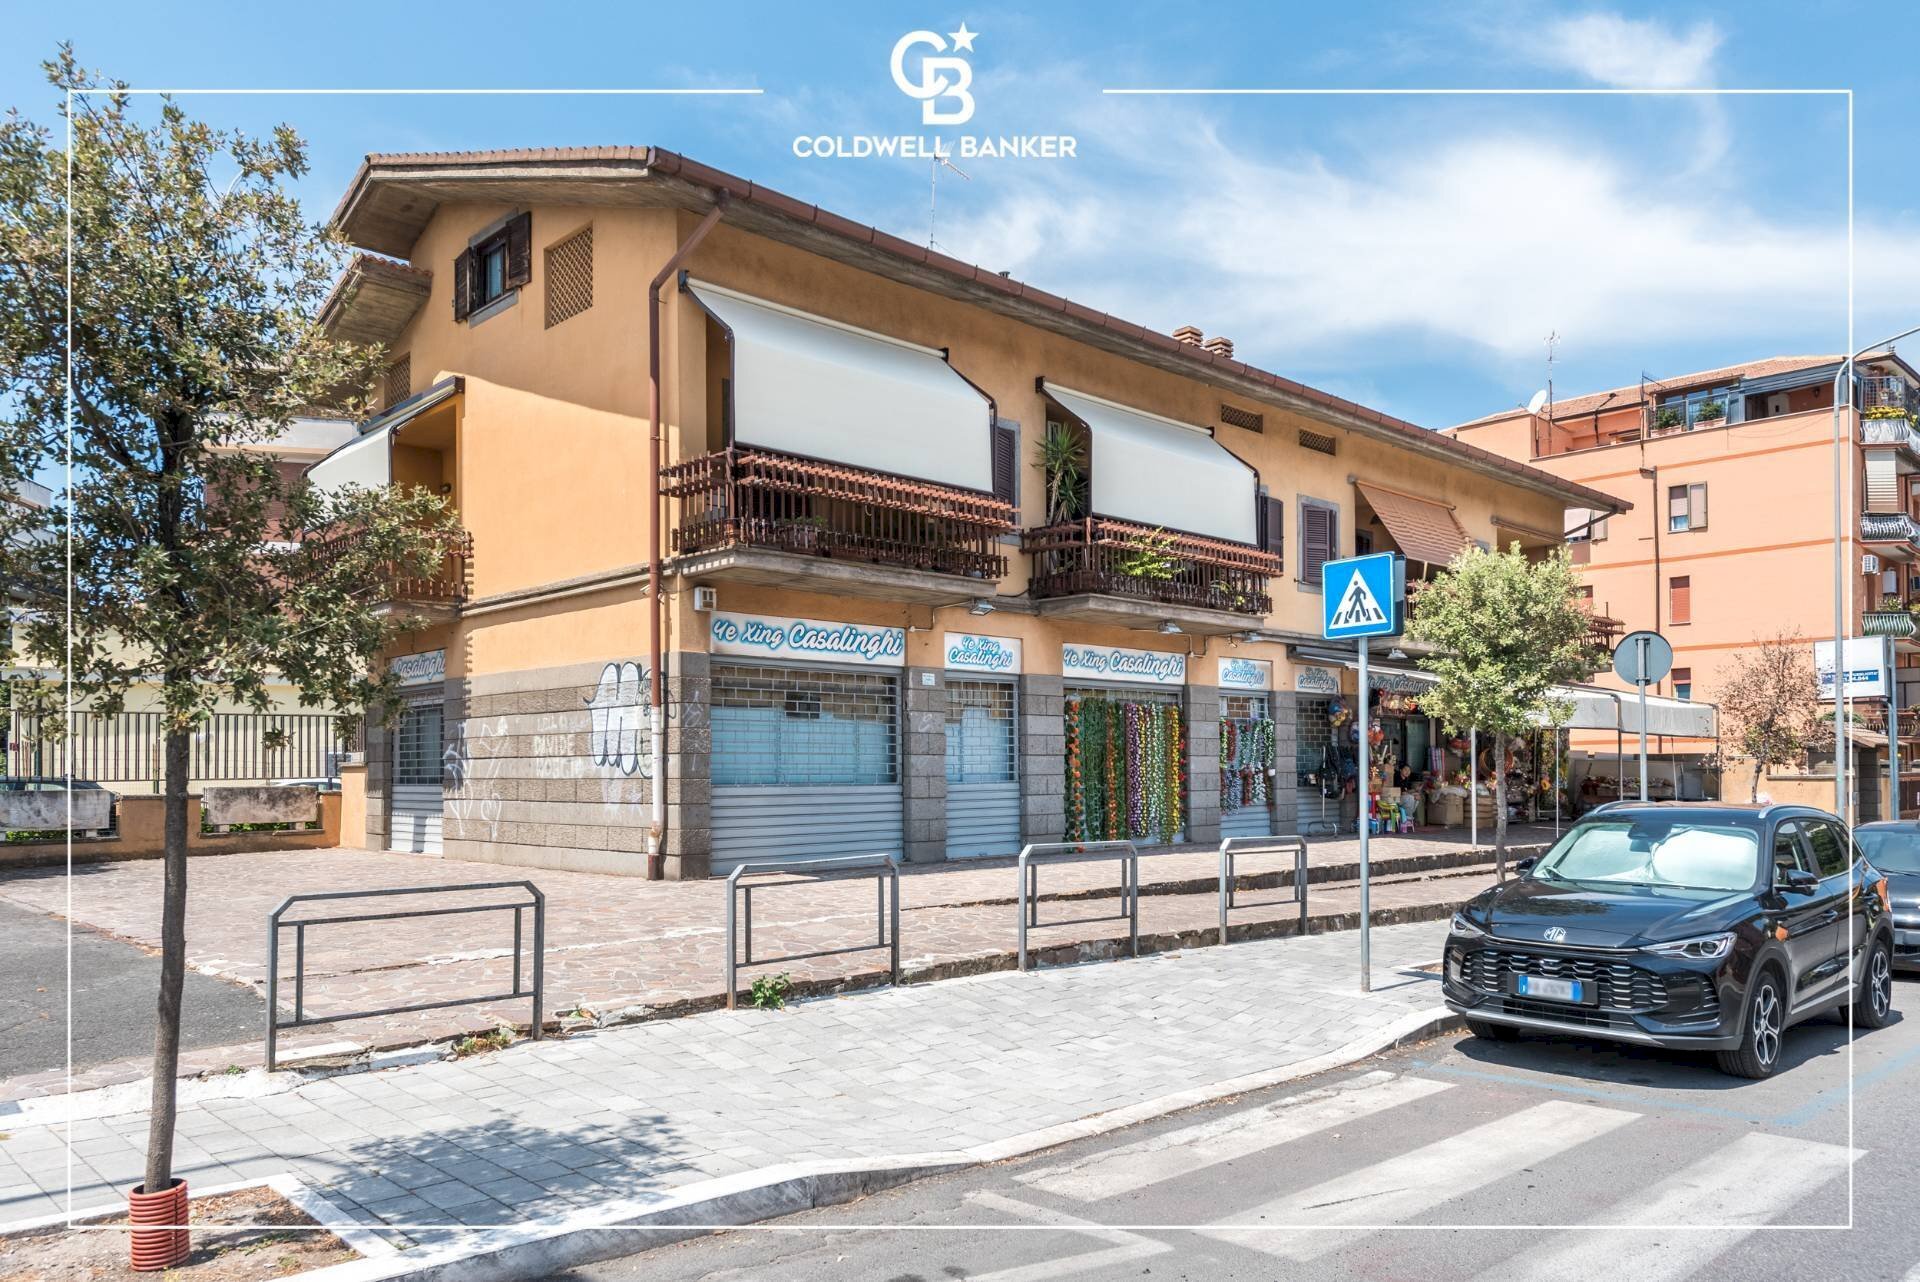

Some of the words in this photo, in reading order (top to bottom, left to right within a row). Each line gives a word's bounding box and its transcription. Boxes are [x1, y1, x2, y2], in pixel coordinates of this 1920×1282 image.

[742, 622, 784, 649] Xing
[788, 623, 903, 660] Casalinghi
[977, 637, 1000, 652] Xing
[949, 647, 1013, 669] Casalinghi
[1081, 651, 1107, 672] Xing
[1110, 651, 1184, 680] Casalinghi
[1222, 668, 1265, 687] Casalinghi
[1298, 675, 1336, 692] Casalinghi
